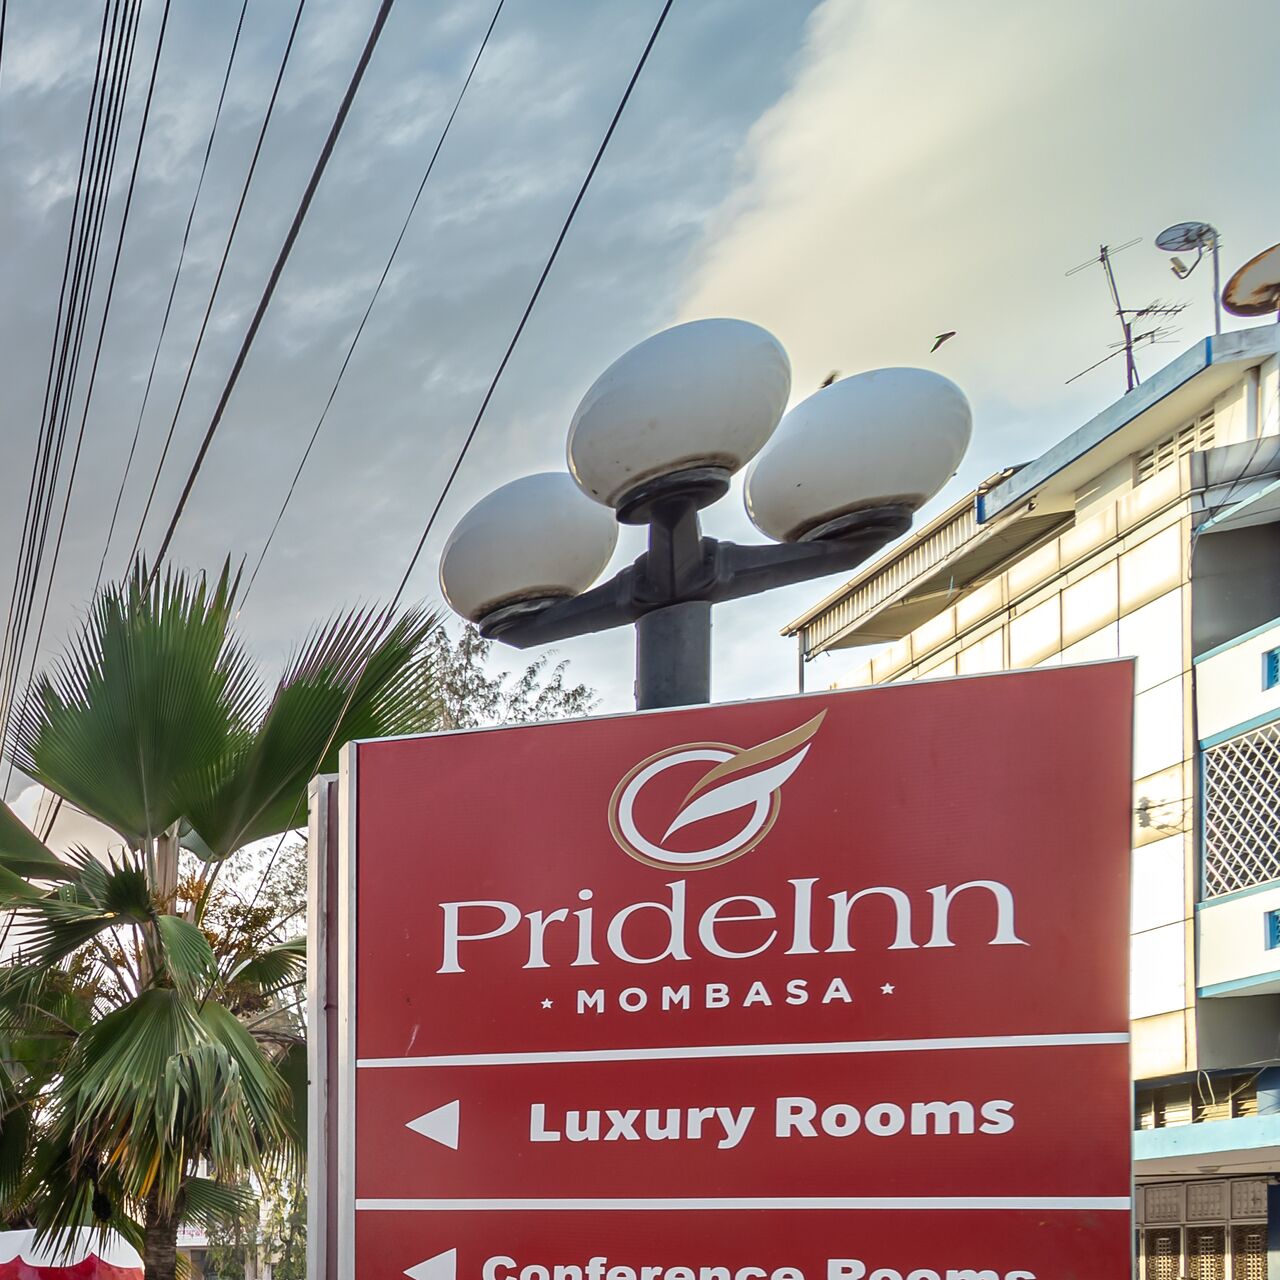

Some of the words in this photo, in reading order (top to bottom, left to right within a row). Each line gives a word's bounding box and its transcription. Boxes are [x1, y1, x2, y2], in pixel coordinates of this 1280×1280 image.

[437, 878, 1030, 974] PrideInn
[578, 978, 852, 1014] MOMBASA
[530, 1103, 756, 1149] Luxury
[775, 1096, 1014, 1138] Rooms
